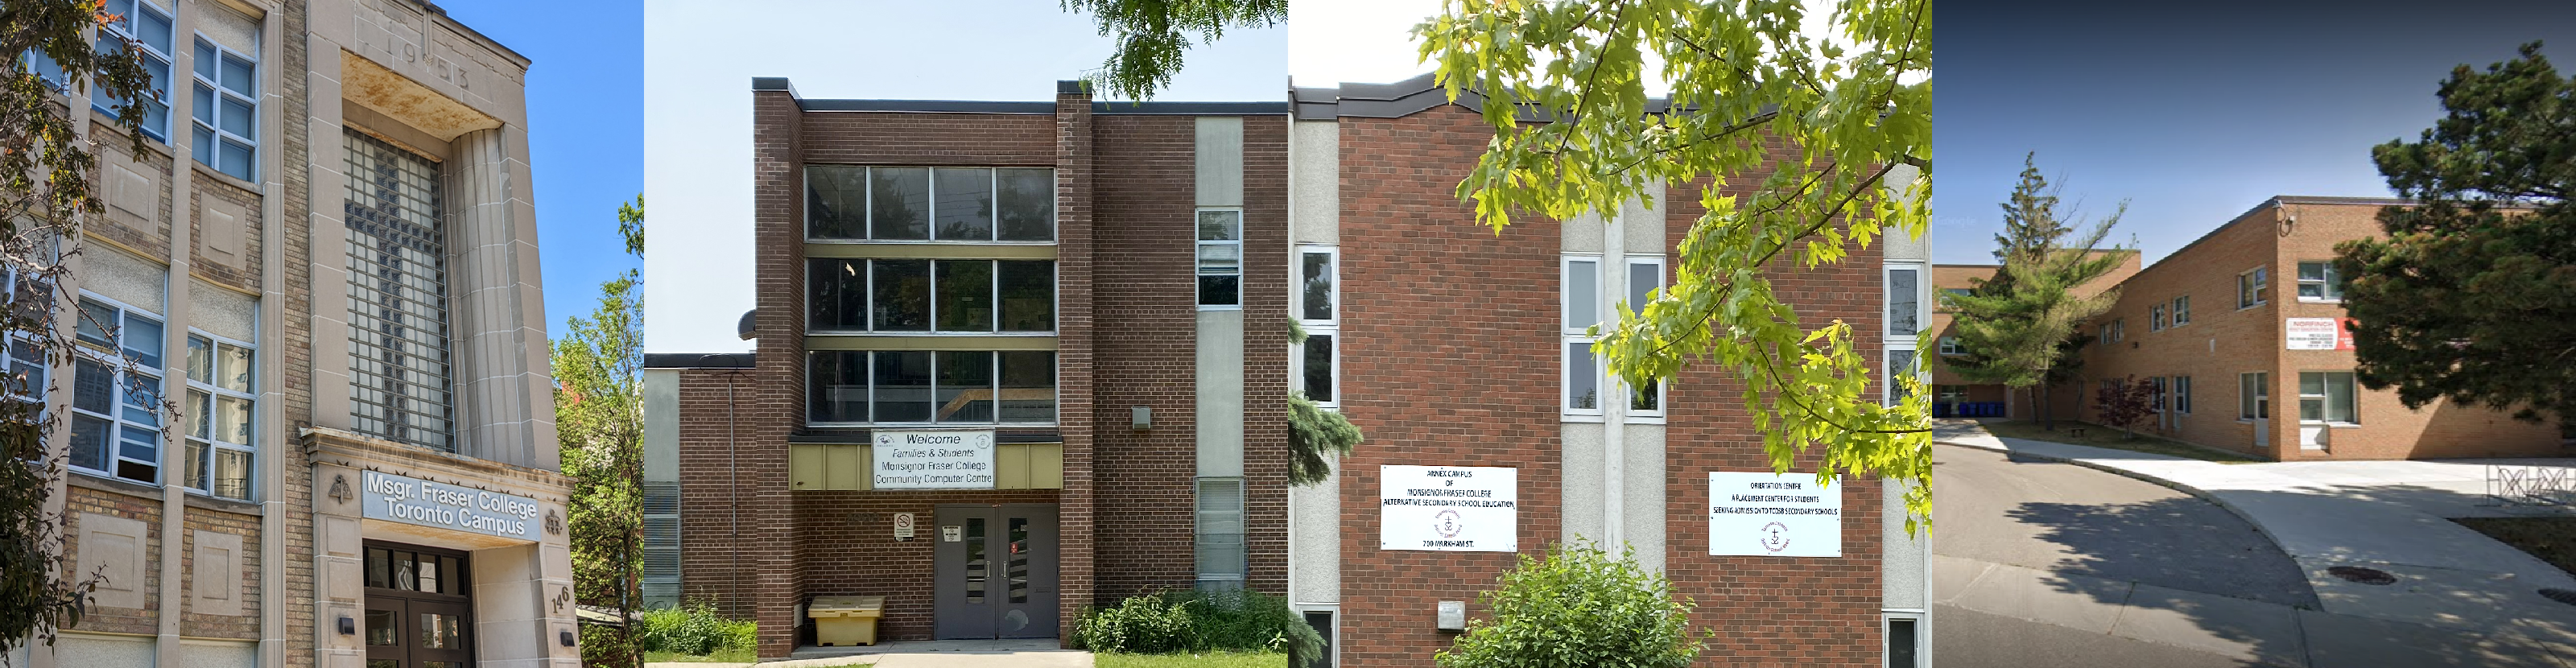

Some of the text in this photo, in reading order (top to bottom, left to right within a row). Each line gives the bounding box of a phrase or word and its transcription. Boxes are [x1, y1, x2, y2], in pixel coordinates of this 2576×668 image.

[386, 35, 469, 89] 1953
[906, 435, 961, 444] Welcome
[893, 449, 974, 458] Families & Students
[882, 461, 986, 472] Monsignor Fraser College
[876, 474, 992, 485] Community Computer Centre
[367, 472, 537, 520] Msgr. Fraser College
[1736, 494, 1764, 502] PLACEMENT
[384, 496, 525, 536] Toronto Campus
[551, 586, 570, 614] 146
